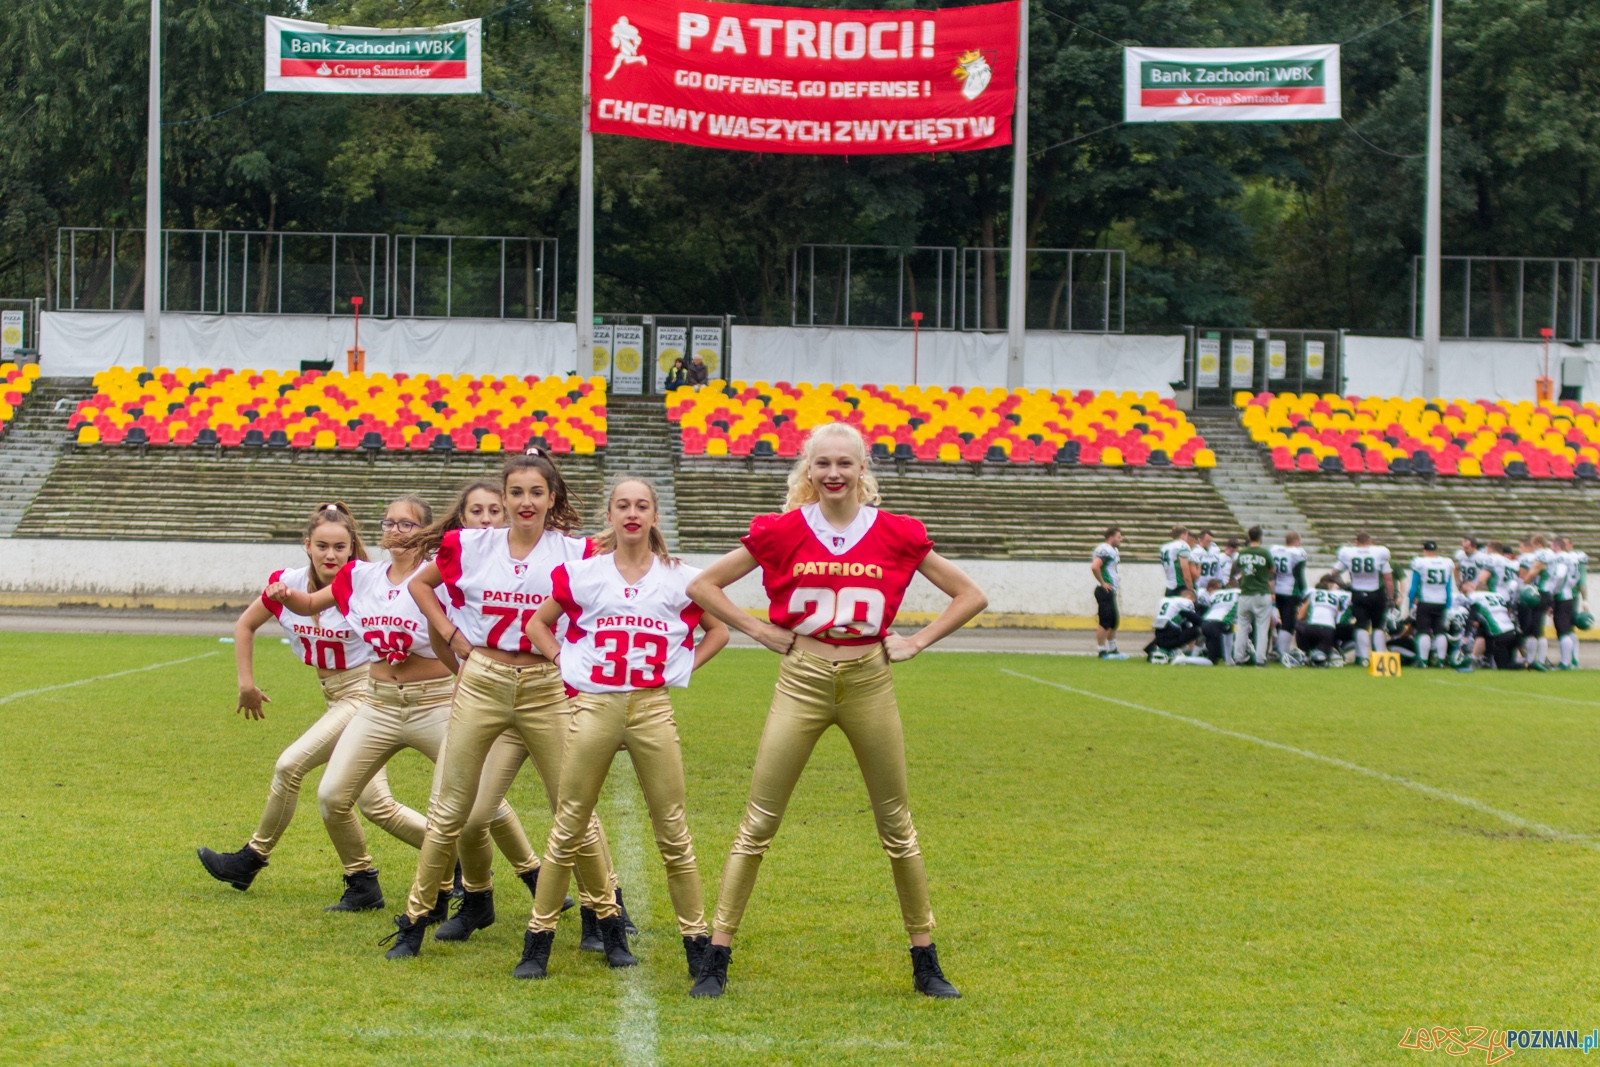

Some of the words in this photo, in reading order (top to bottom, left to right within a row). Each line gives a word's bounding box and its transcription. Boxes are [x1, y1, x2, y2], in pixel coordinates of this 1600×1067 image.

[677, 12, 936, 60] PATRIOCI!
[291, 38, 331, 54] Bank
[335, 40, 410, 55] Zachodni
[414, 39, 455, 55] WBK
[334, 64, 371, 78] Grupa
[373, 65, 431, 77] Santander
[1151, 68, 1192, 83] Bank
[1195, 67, 1270, 83] Zachodni
[1272, 67, 1314, 82] WBK
[674, 69, 702, 88] GO
[829, 81, 919, 98] DEFENSE
[1194, 93, 1231, 107] Grupa
[1233, 92, 1290, 105] Santander
[597, 97, 706, 132] CHCEMY
[708, 113, 831, 142] WASZYCH
[834, 115, 996, 145] ZWYCIĘSTW
[1161, 549, 1170, 566] 4
[1351, 556, 1376, 574] 88
[792, 561, 883, 580] PATRIOCI
[1427, 569, 1447, 585] 51
[483, 590, 550, 606] PATRIO
[1314, 590, 1338, 606] 25
[1159, 601, 1169, 617] 9
[293, 624, 350, 639] PATRIOCI
[361, 616, 418, 632] PATRIOCI
[596, 616, 669, 632] PATRIOCI
[590, 629, 669, 689] 33
[1375, 655, 1399, 677] 40
